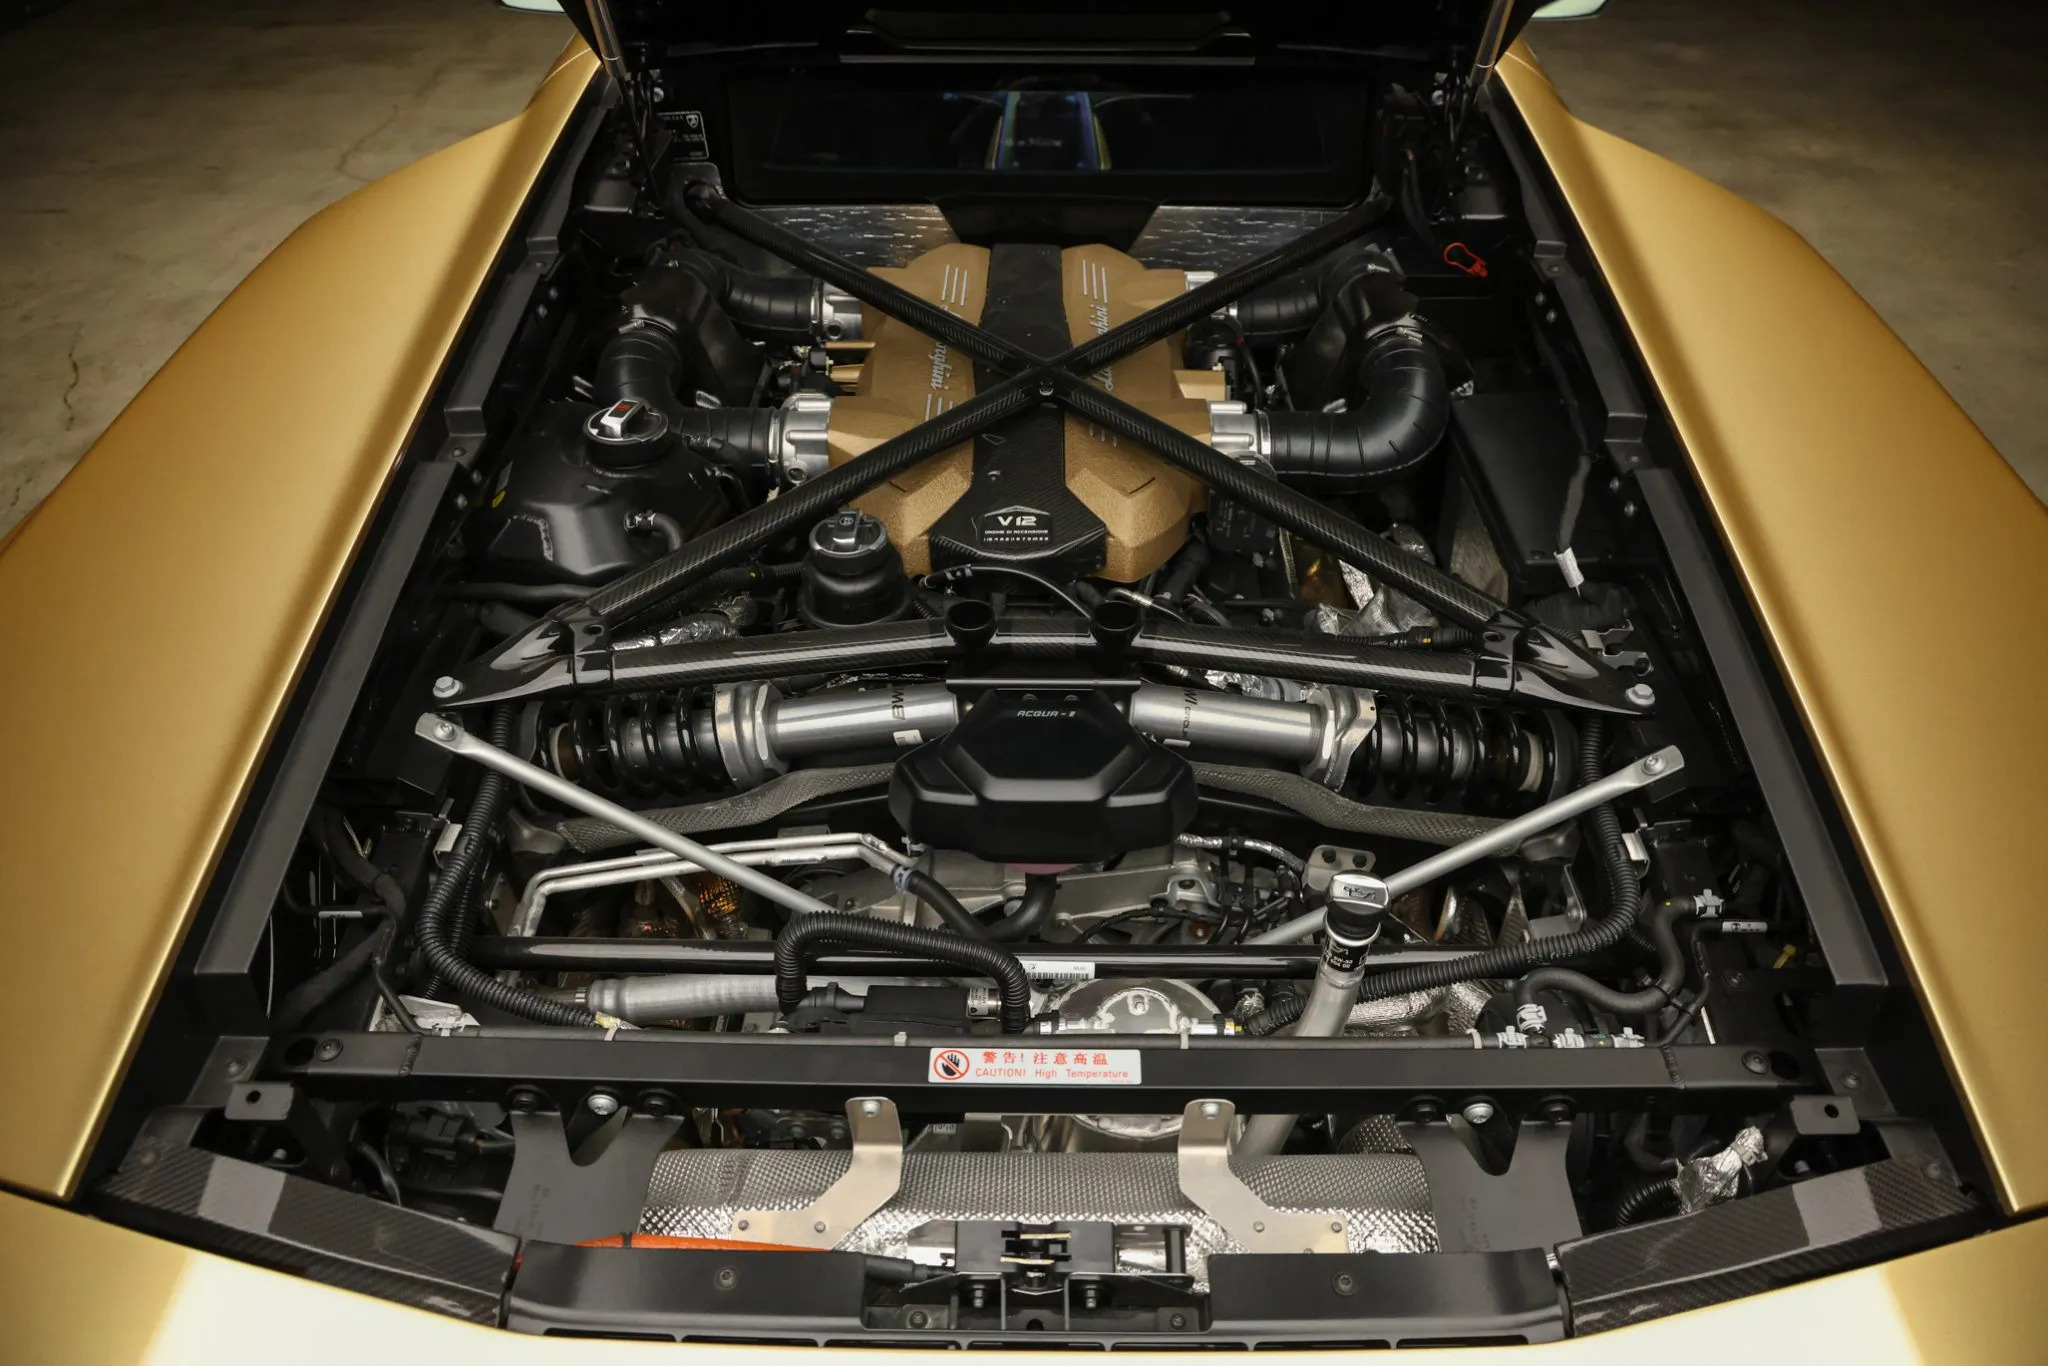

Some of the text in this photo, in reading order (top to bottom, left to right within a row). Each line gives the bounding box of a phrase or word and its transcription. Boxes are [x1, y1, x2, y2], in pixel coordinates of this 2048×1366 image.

[997, 515, 1037, 526] V12
[1016, 710, 1059, 718] ACQUA
[975, 1068, 1129, 1079] CAUTION! High Temperature
